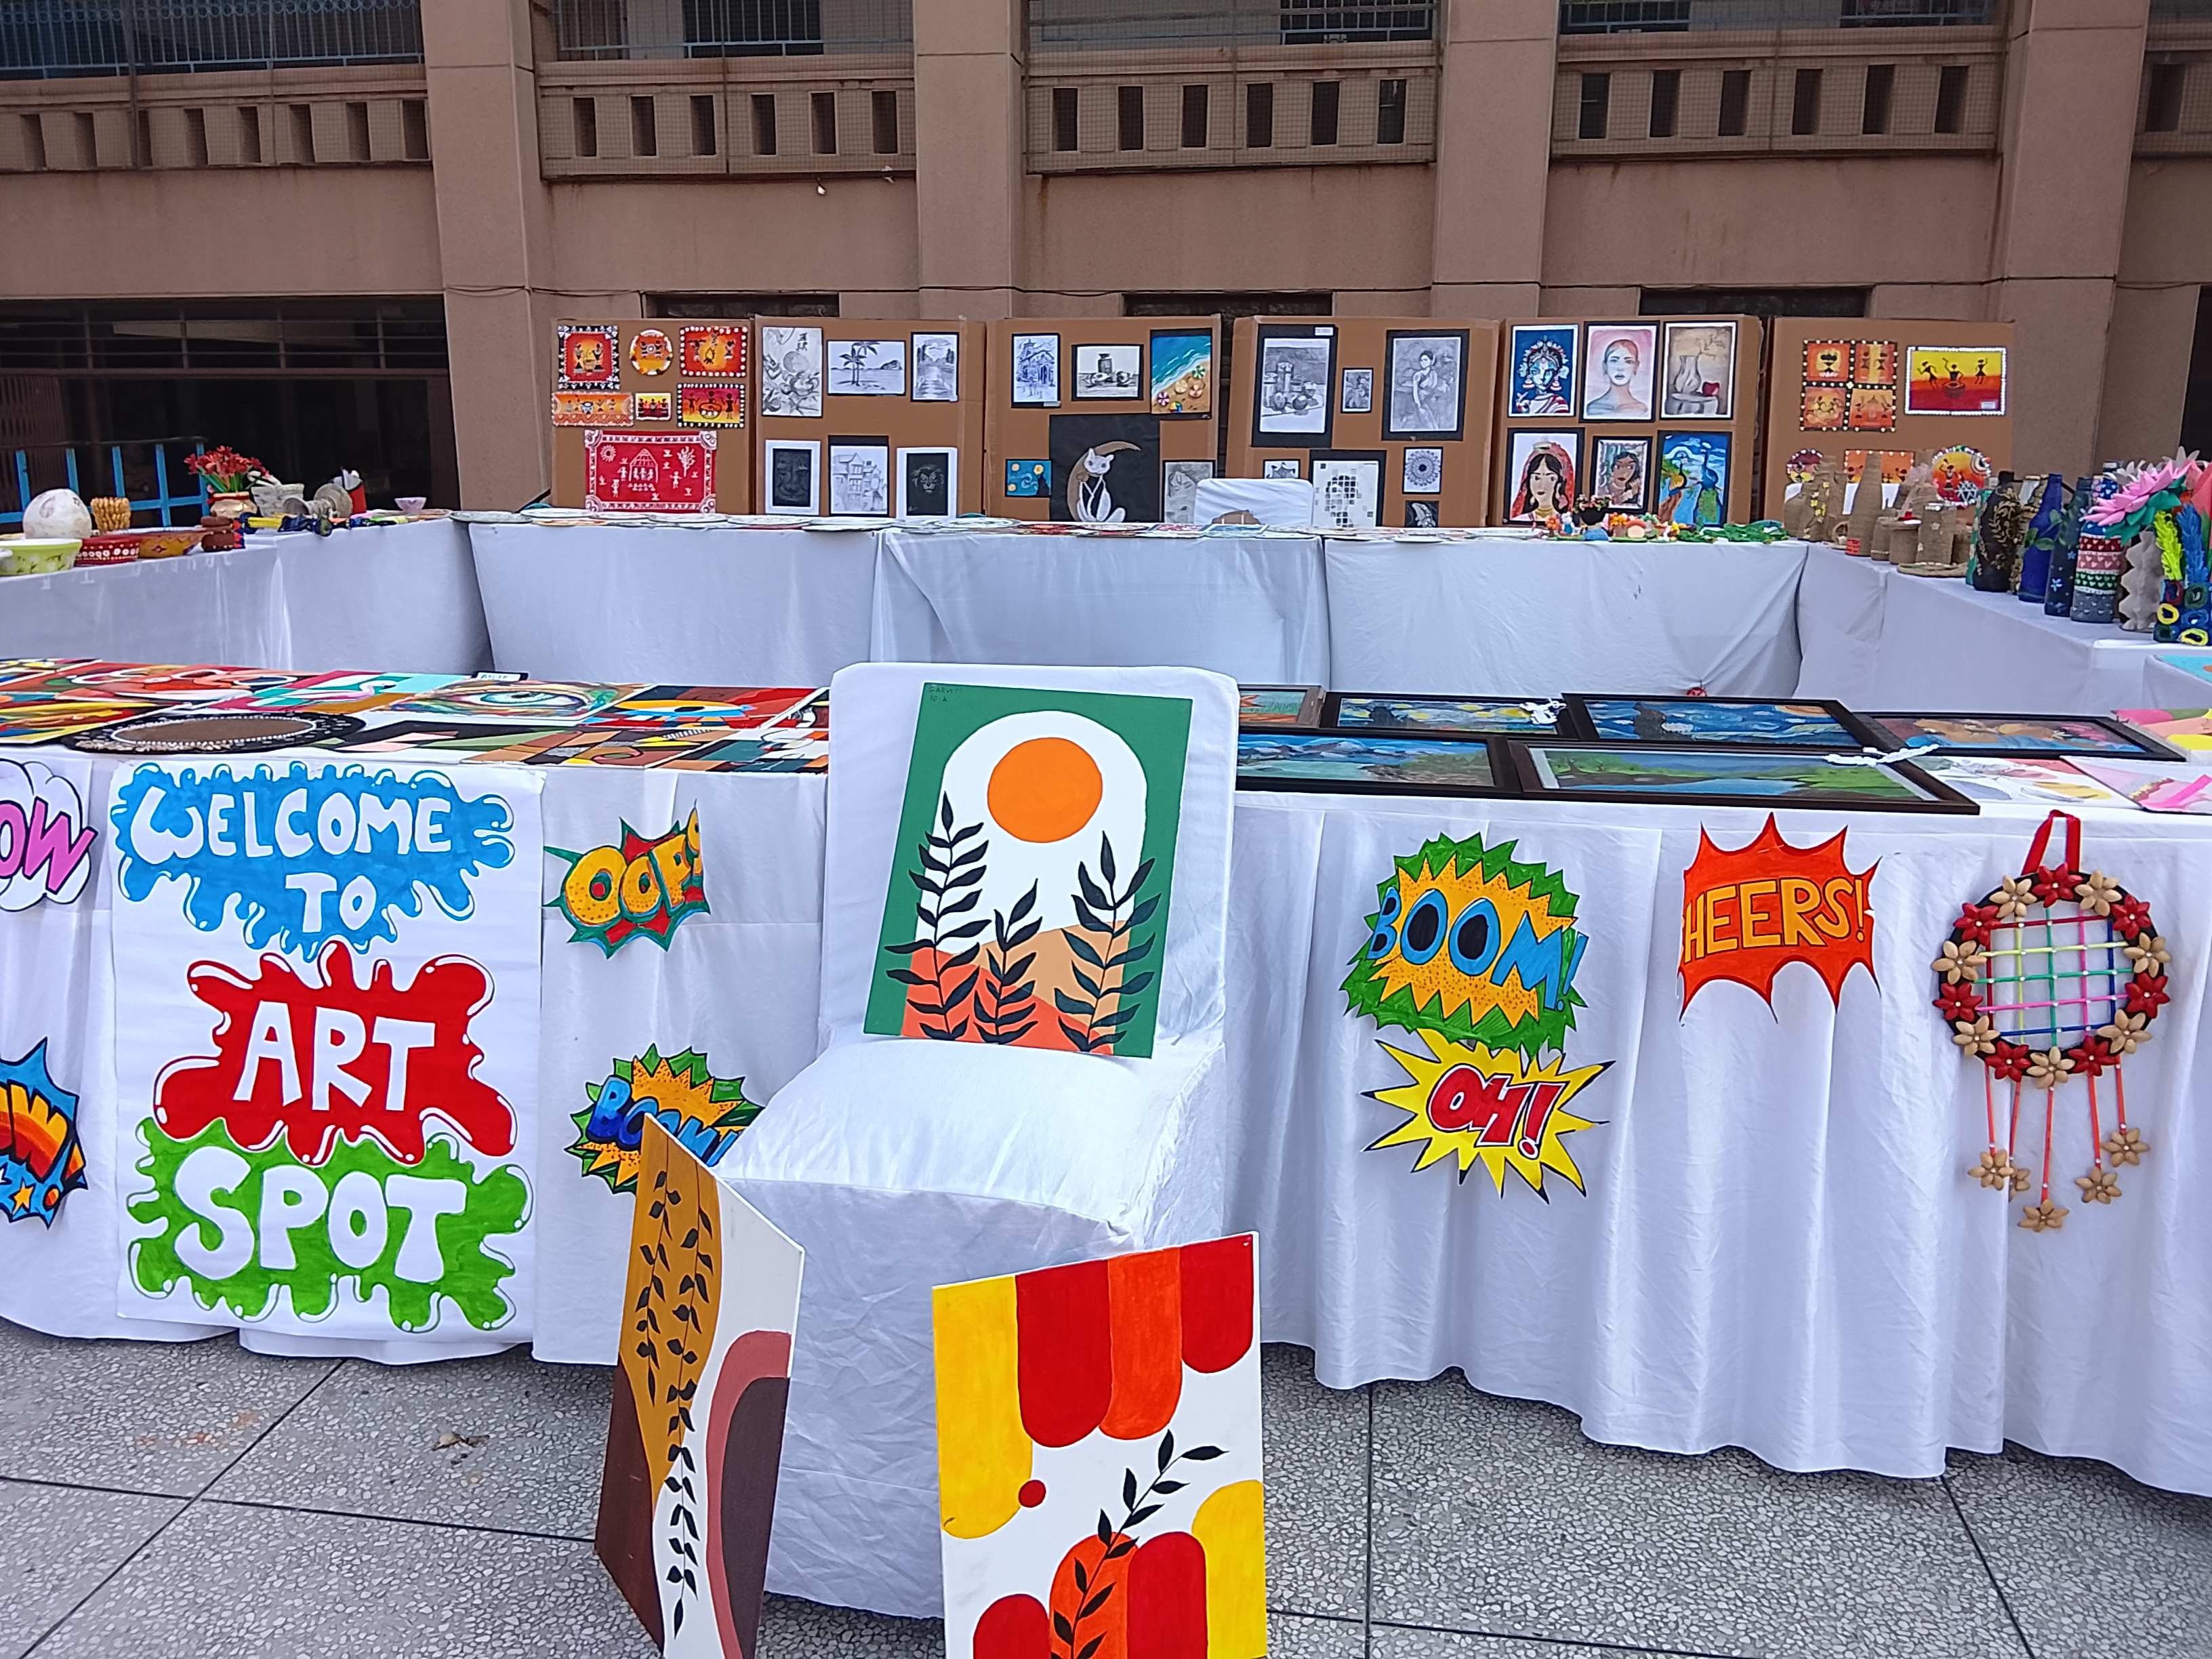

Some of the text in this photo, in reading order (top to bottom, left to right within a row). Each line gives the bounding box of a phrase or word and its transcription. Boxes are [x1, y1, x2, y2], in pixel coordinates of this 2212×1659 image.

[132, 787, 452, 865] WELCOME
[285, 873, 377, 933] TO
[1366, 886, 1590, 1012] BOOM!
[1681, 877, 1864, 962] HEERS!
[232, 1000, 436, 1111] ART
[1426, 1063, 1570, 1160] OH!
[173, 1145, 468, 1284] SPOT
